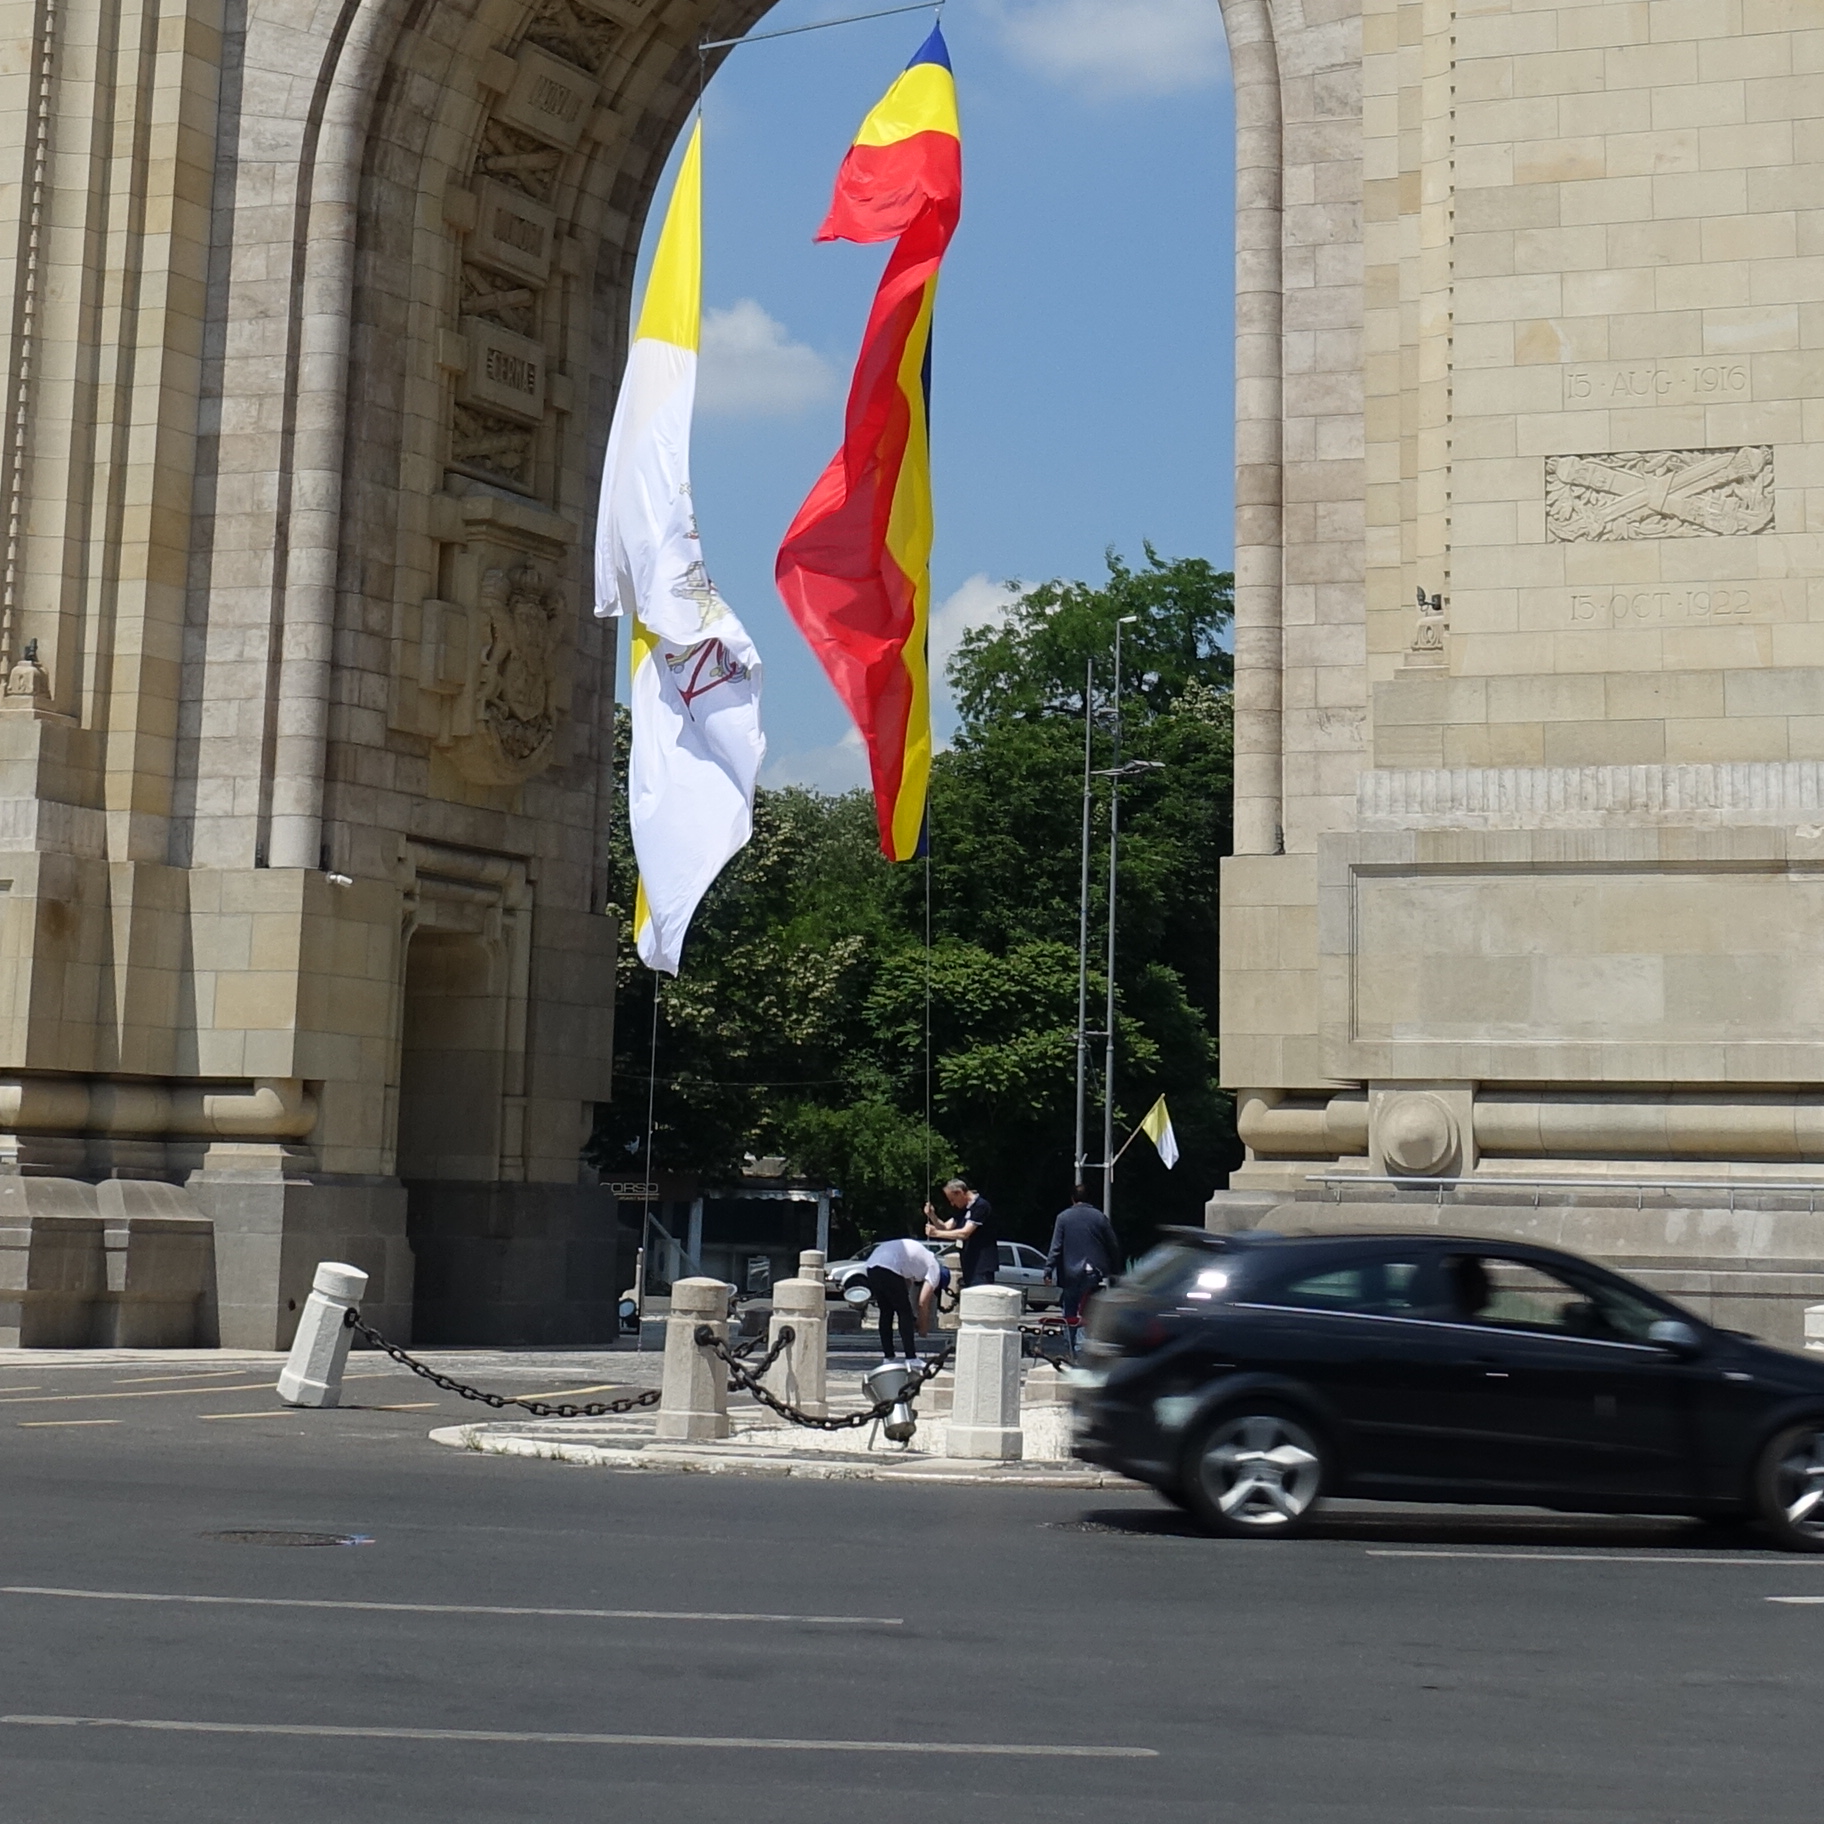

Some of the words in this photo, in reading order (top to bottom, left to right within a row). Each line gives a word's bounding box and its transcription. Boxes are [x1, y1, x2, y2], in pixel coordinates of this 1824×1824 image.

[1566, 372, 1591, 400] 15
[1610, 369, 1673, 398] AUG
[1692, 365, 1747, 394] 1916
[1570, 593, 1595, 622] 15
[1611, 591, 1670, 620] OCT
[1686, 589, 1753, 617] 1922
